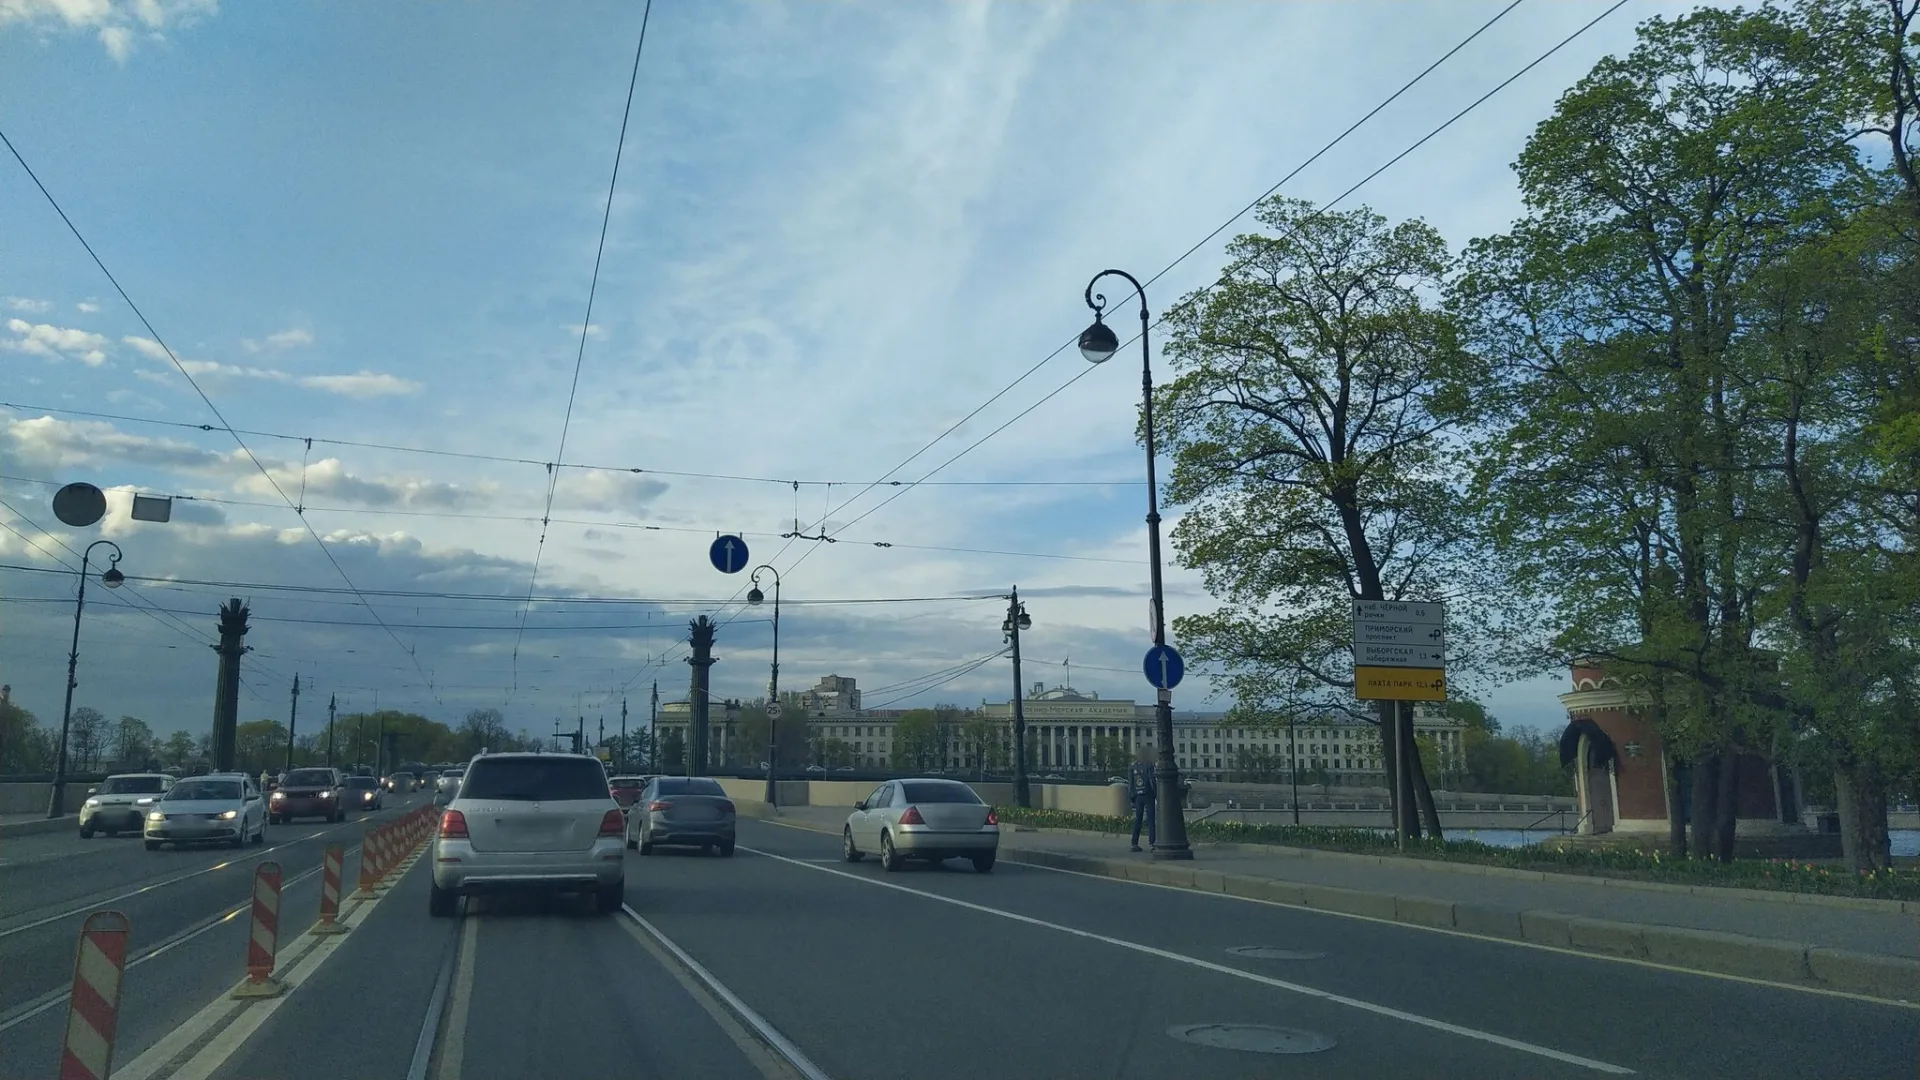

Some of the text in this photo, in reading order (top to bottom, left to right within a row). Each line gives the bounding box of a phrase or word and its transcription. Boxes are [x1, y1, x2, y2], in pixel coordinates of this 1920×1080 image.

[1380, 603, 1408, 612] ЧЁРНОЙ
[1365, 624, 1413, 634] ПРИМОРСКИЙ
[1366, 646, 1414, 655] ВЫБОРГСКАЯ
[1366, 655, 1407, 663] набережная
[1368, 680, 1391, 688] ЛАХТА
[1393, 680, 1412, 688] ПАРК
